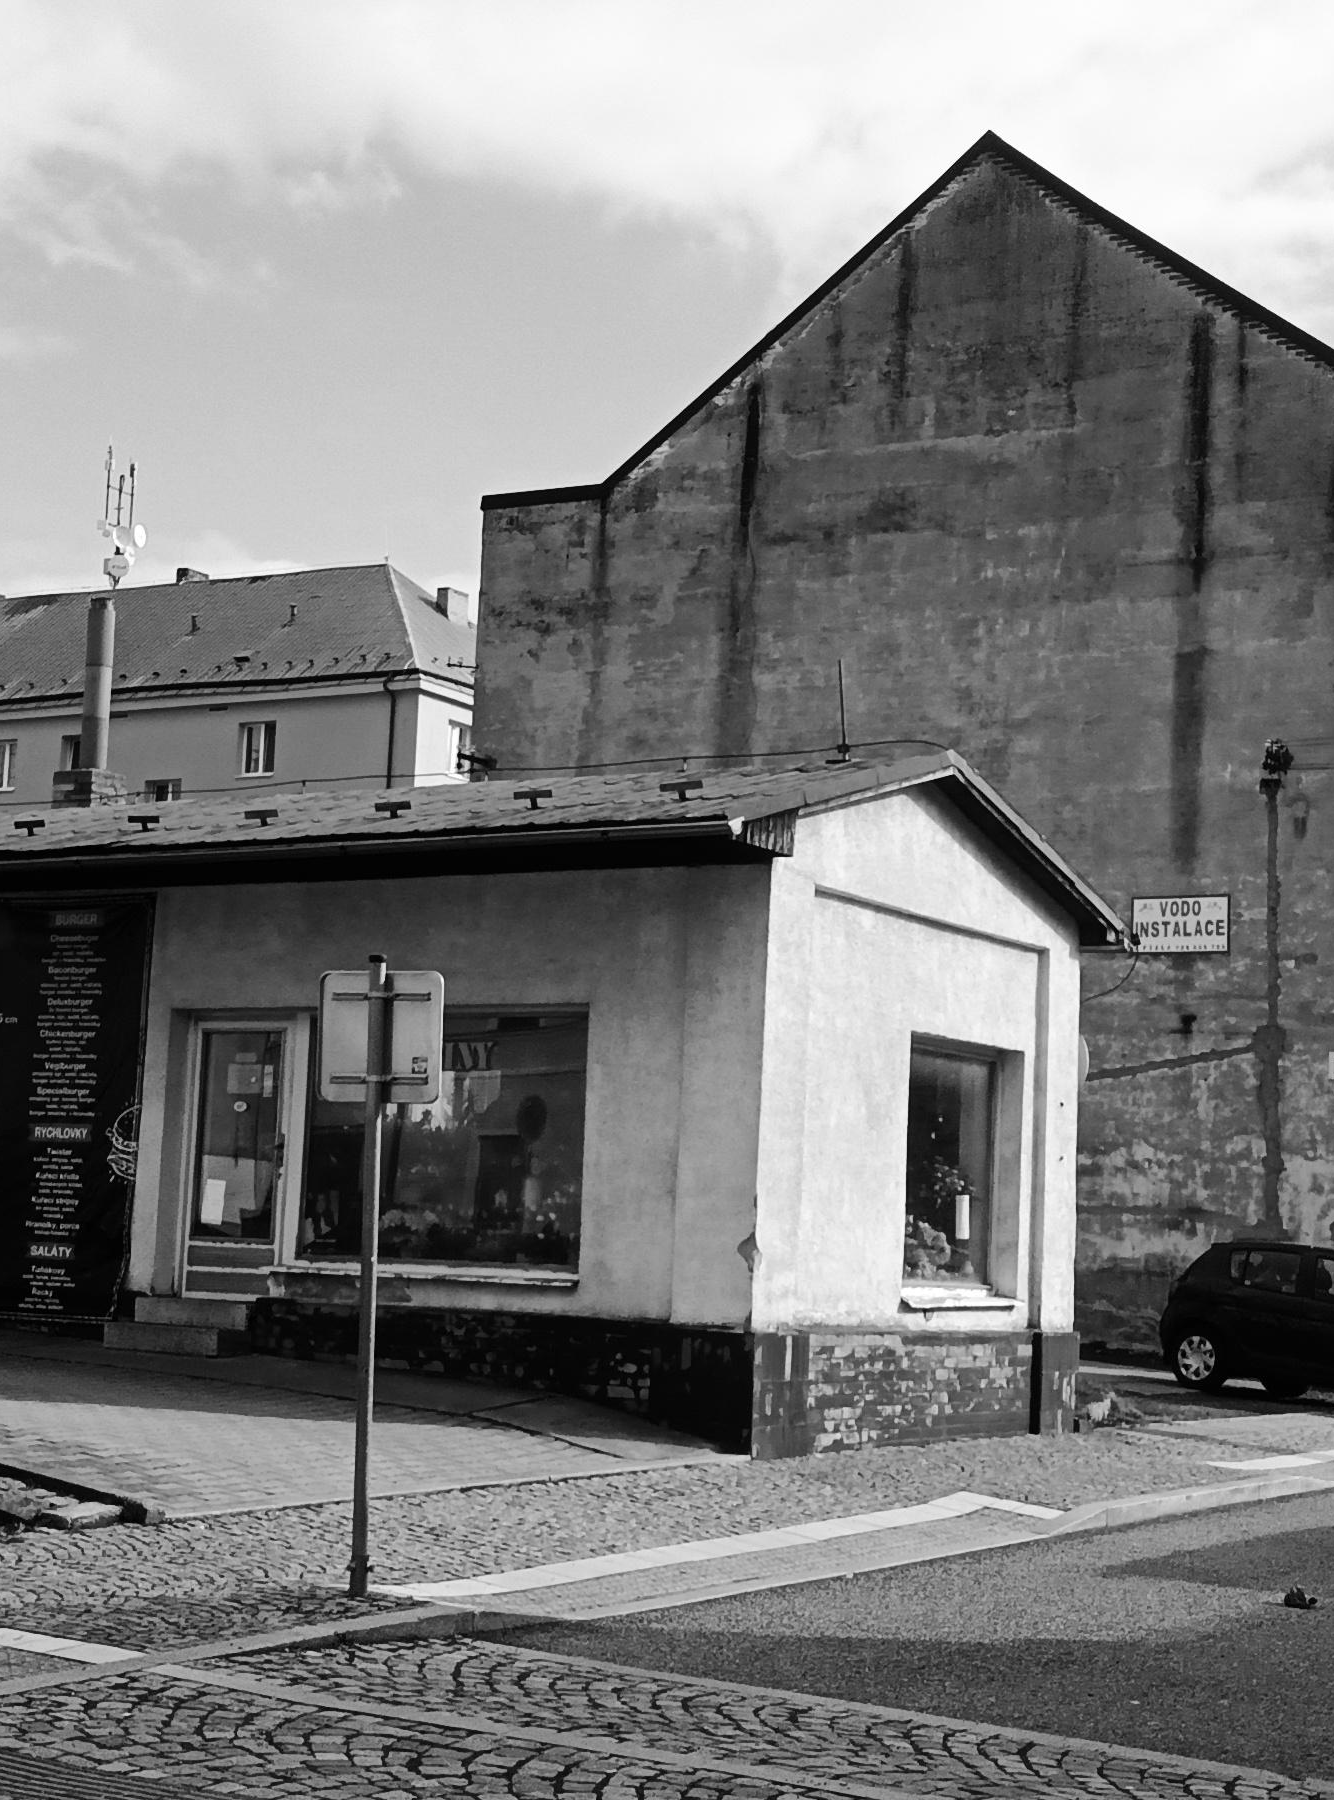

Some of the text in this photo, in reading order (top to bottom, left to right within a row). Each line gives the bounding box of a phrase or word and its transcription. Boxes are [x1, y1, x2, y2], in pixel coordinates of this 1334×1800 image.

[1159, 900, 1202, 917] VODO
[55, 913, 98, 926] BURGER
[1135, 920, 1226, 938] INSTALACE
[48, 966, 97, 975] Baconburger
[5, 1015, 18, 1024] cm
[39, 1029, 96, 1039] Chickenburger
[34, 1126, 88, 1139] RYCHLOVKY
[29, 1243, 73, 1258] SALÁTY
